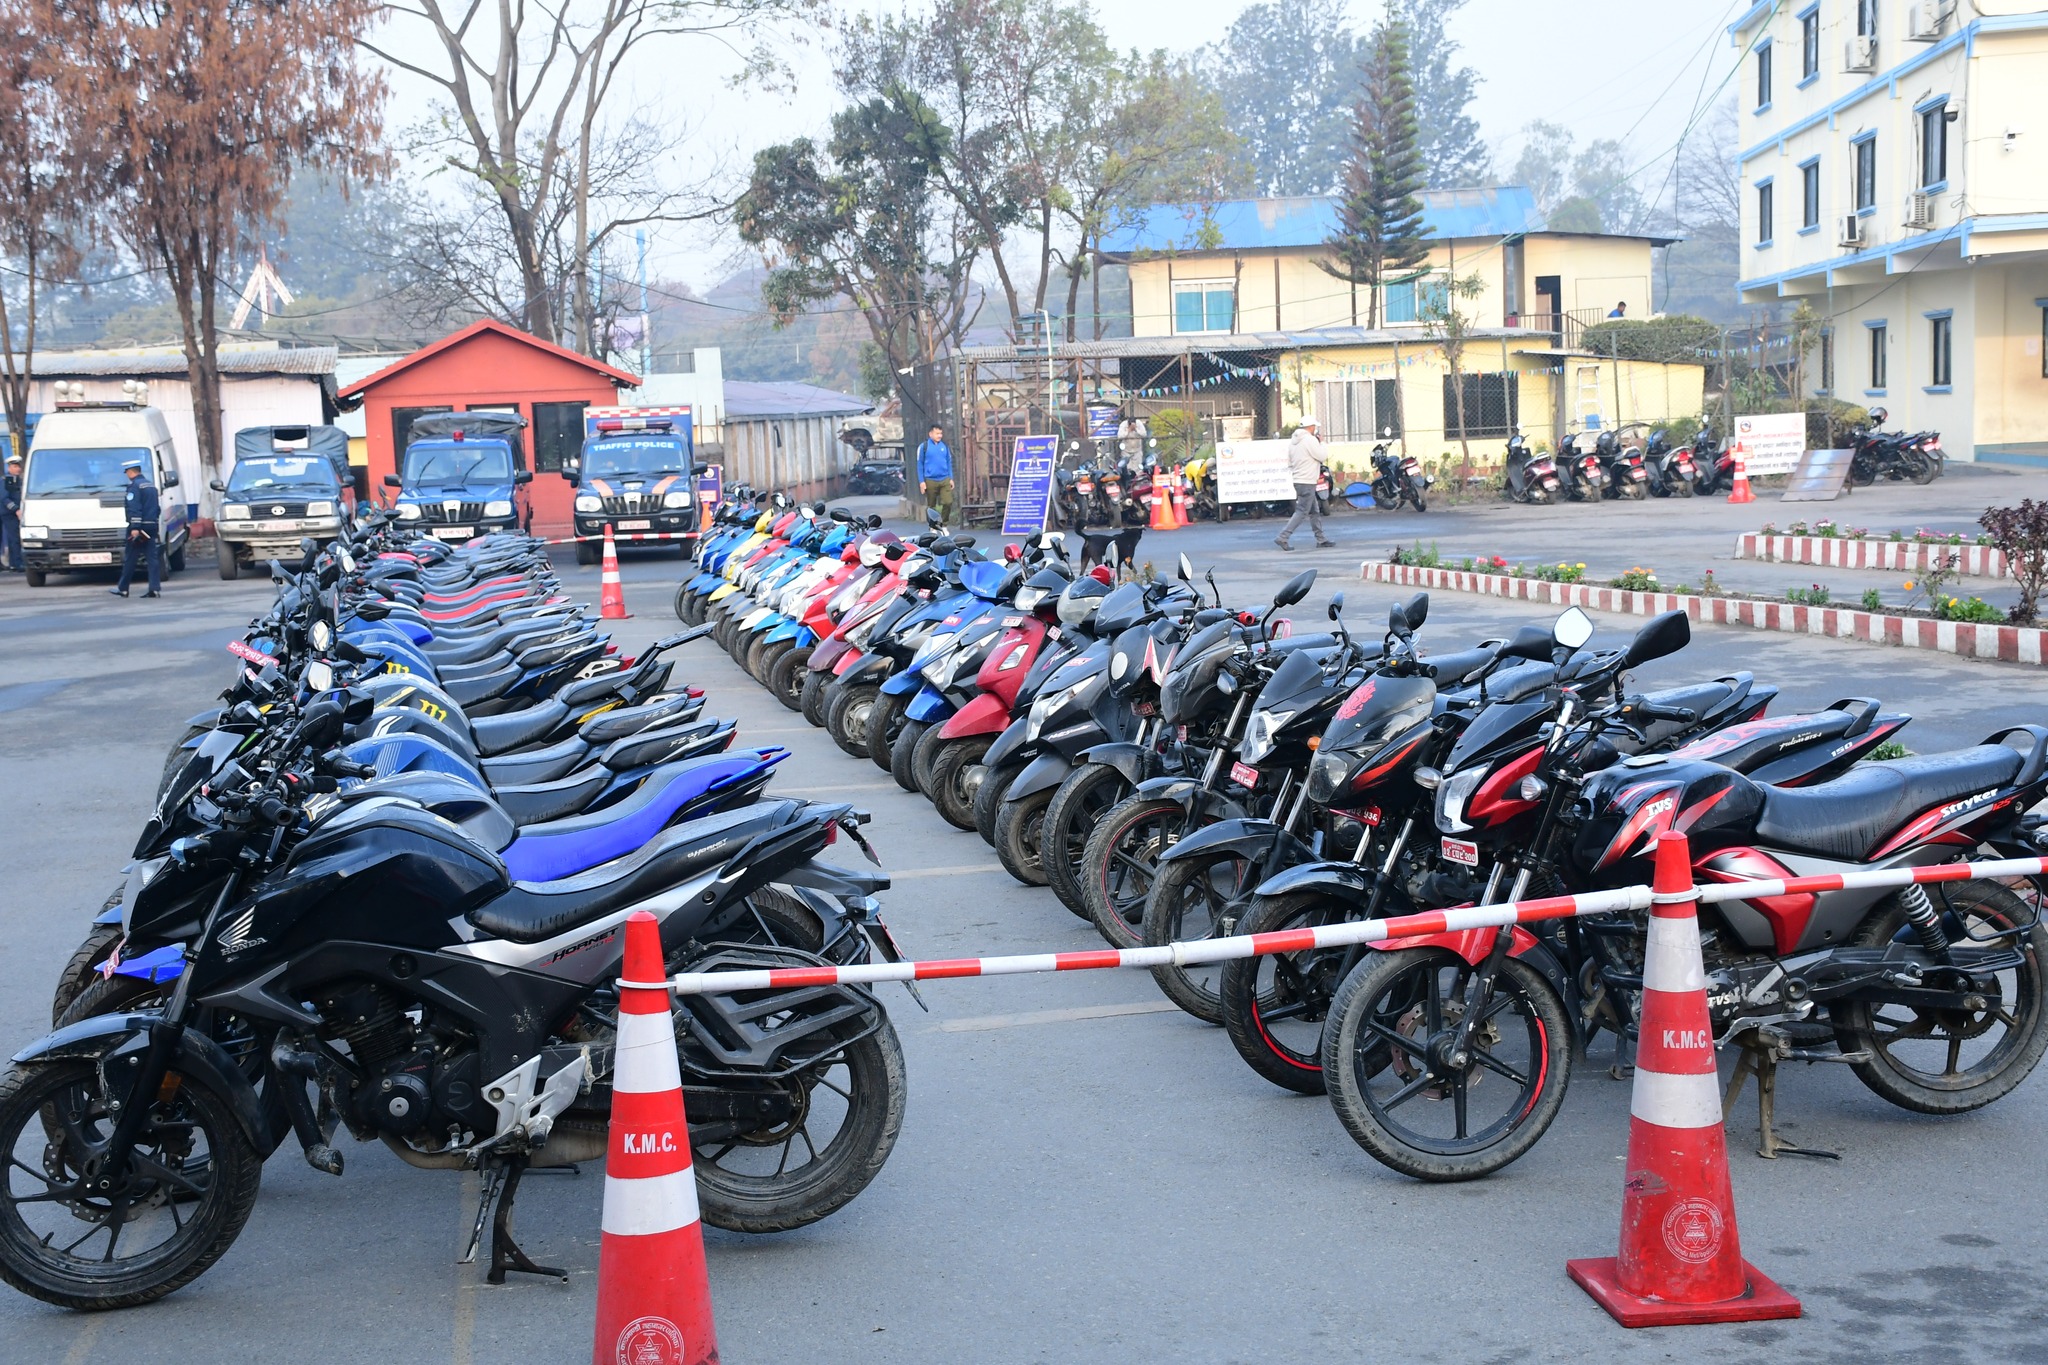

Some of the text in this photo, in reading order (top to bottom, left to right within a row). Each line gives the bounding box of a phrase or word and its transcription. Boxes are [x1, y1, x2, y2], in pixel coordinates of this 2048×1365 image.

[594, 441, 674, 451] TRAFFIC POLICE
[244, 458, 278, 466] TRAFFIC
[1831, 741, 1853, 757] 150
[1646, 797, 1673, 817] TVS
[1940, 788, 1998, 818] Stryker
[221, 938, 268, 956] HONDA
[552, 927, 619, 963] HORNET
[1707, 994, 1731, 1007] TVS
[624, 1132, 677, 1154] K.M.C.
